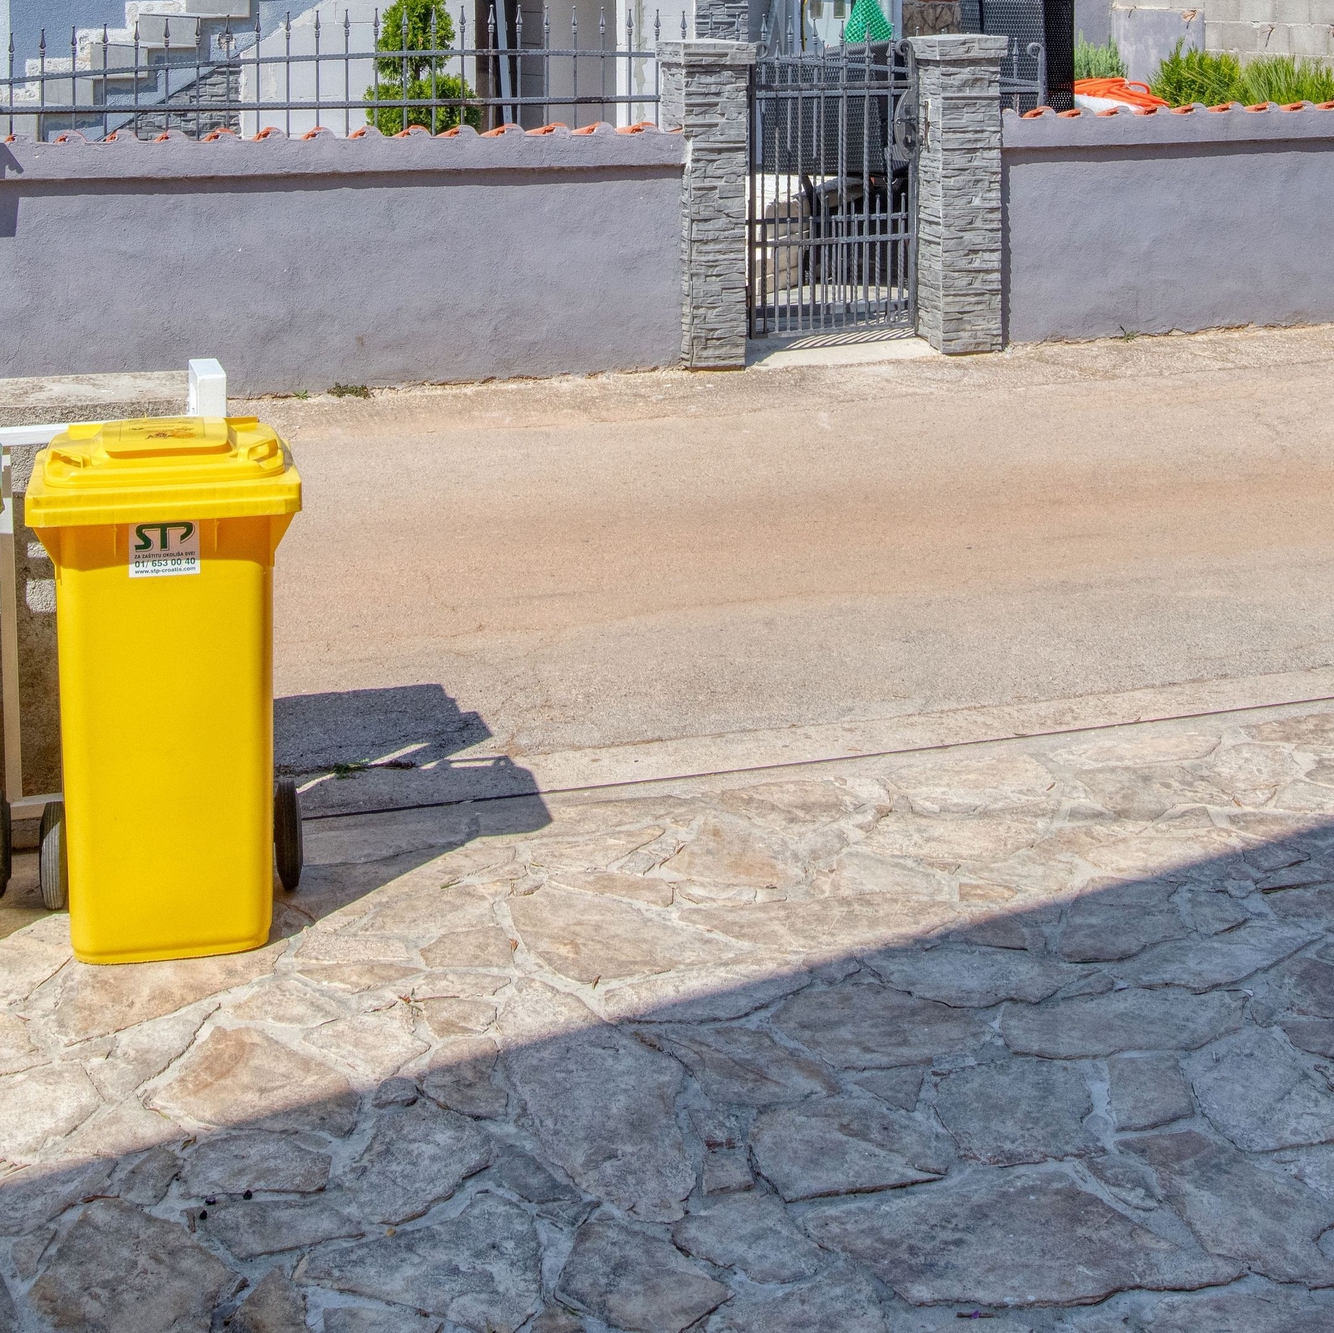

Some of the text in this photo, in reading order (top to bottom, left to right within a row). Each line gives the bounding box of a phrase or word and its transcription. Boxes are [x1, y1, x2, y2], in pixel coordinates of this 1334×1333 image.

[134, 521, 196, 552] STP
[151, 559, 168, 567] 653
[170, 558, 182, 566] 00
[184, 557, 196, 565] 40
[134, 566, 196, 574] www.stp-croatia.com
